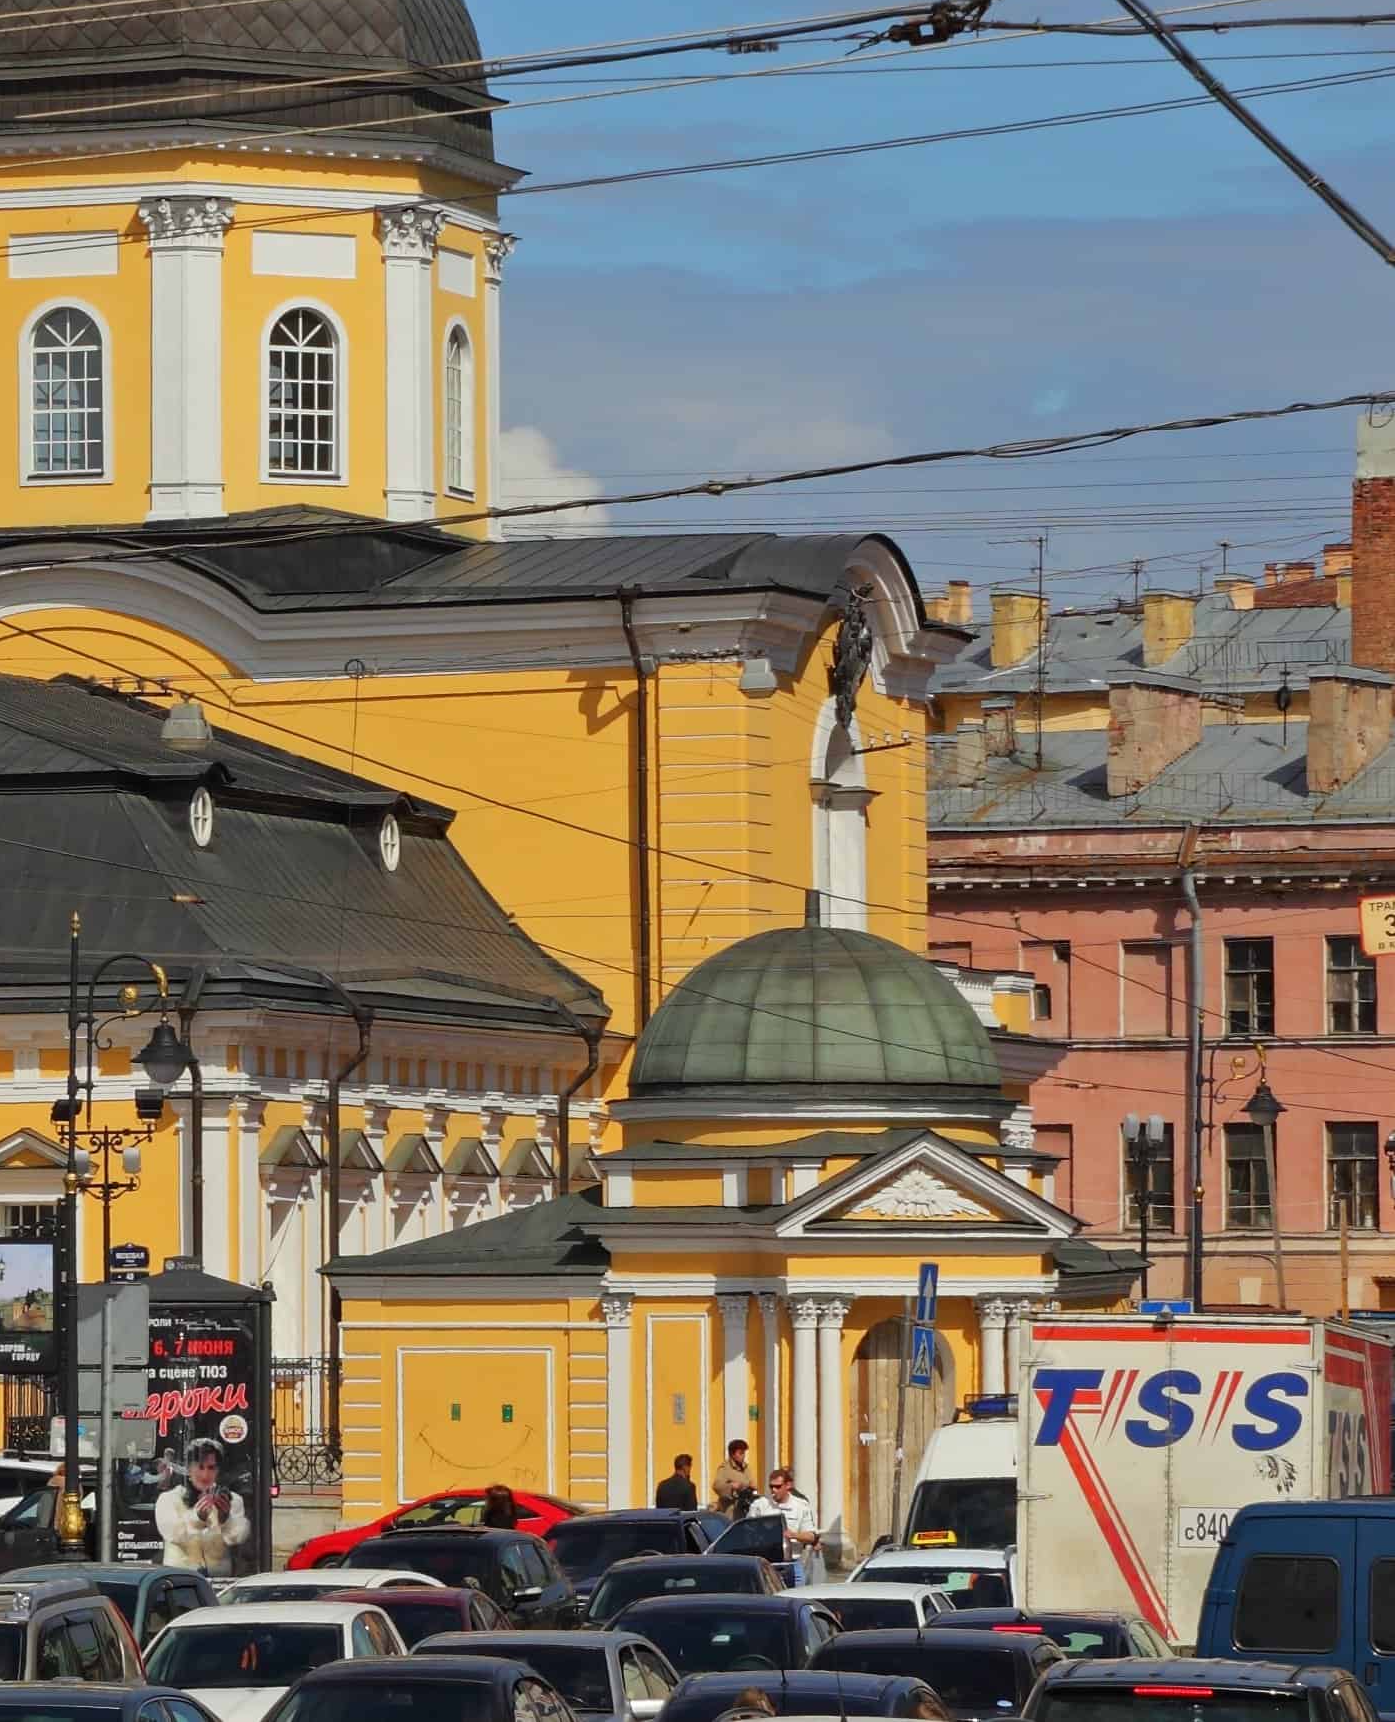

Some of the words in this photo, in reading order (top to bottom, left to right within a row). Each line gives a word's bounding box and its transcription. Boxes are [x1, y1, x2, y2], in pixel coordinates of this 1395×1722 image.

[174, 1340, 183, 1355] 7
[188, 1340, 233, 1355] ИЮНЯ
[159, 1368, 196, 1380] сцене
